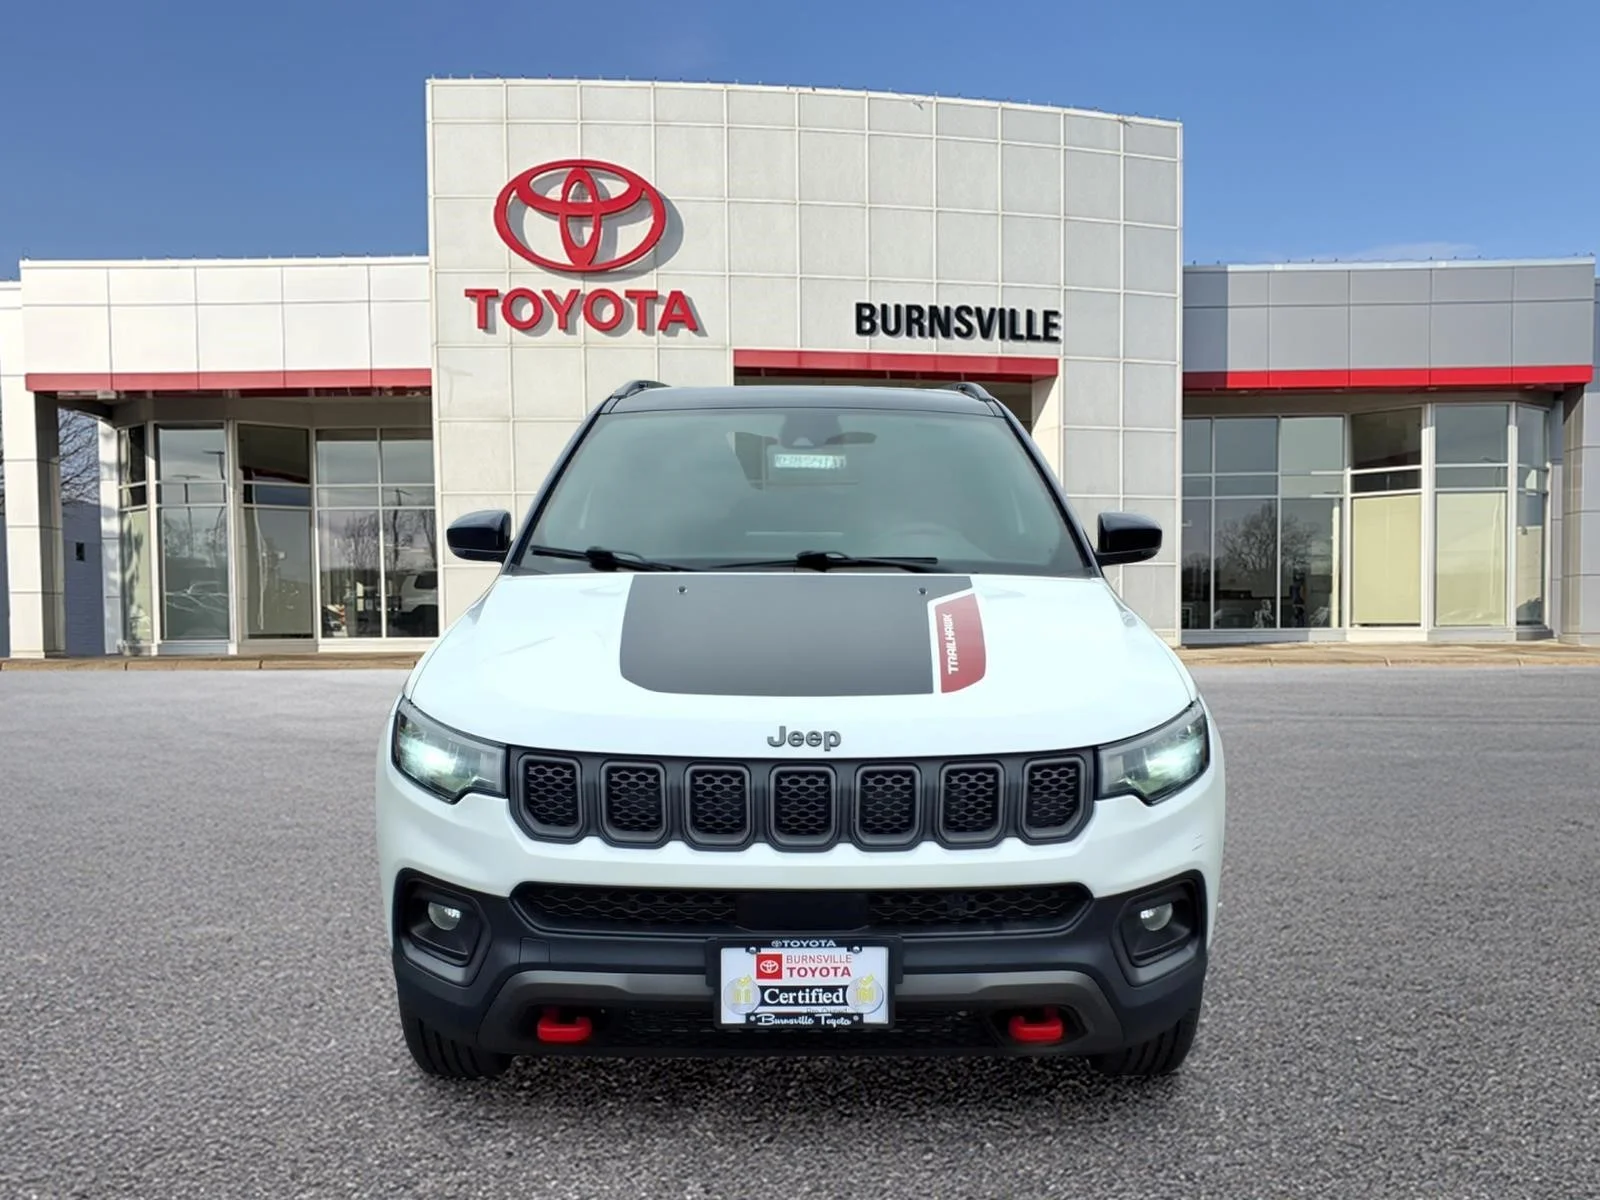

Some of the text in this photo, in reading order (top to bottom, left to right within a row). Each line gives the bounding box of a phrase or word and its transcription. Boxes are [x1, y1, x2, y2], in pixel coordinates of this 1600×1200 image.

[464, 287, 699, 332] TOYOTA
[855, 302, 1061, 342] BURNSVILLE
[942, 613, 959, 675] TRAILHAWK
[767, 725, 842, 752] Jeep
[781, 939, 837, 948] TOYOTA
[785, 954, 853, 964] BURNSVILLE
[786, 966, 852, 978] TOYOTA
[763, 988, 845, 1005] Certified
[756, 1013, 852, 1028] Burnsville Toyota
